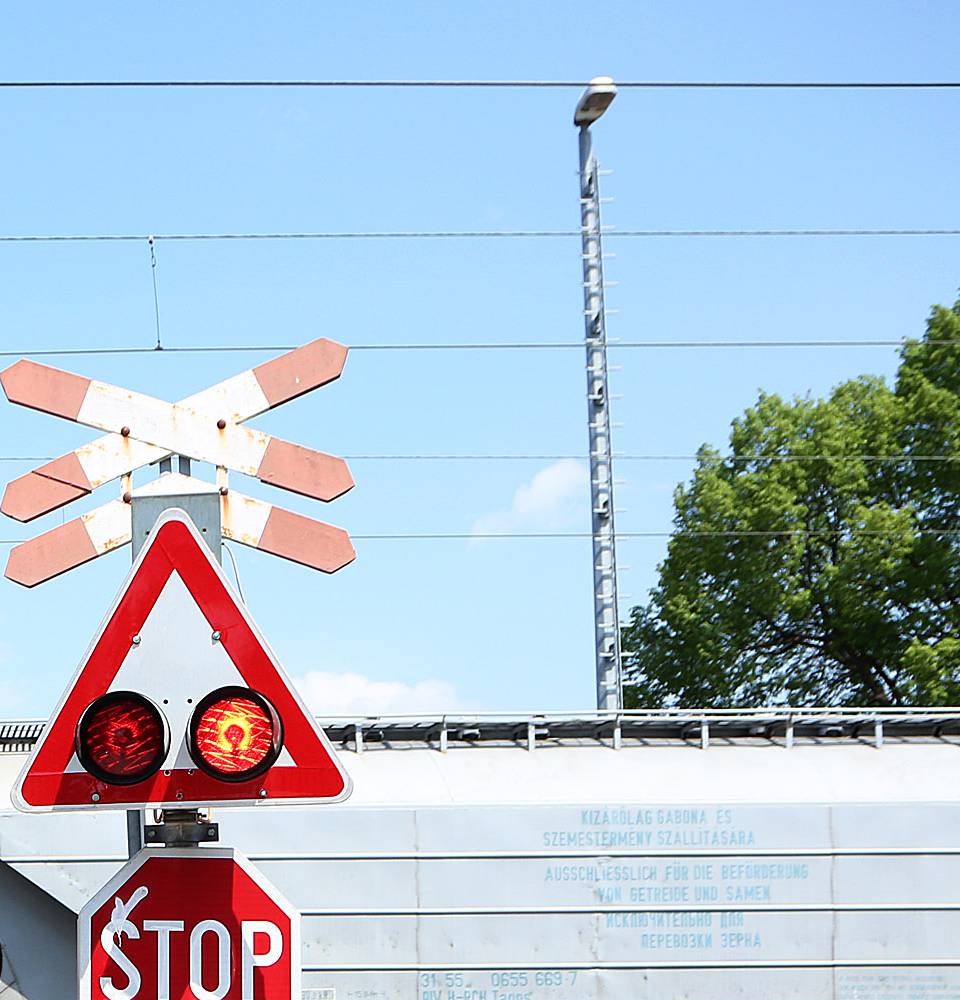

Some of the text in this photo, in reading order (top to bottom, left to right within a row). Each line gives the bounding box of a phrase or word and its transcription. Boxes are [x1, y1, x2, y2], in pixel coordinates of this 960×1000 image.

[657, 809, 706, 825] GABONA
[716, 806, 732, 824] ÉS
[544, 866, 657, 881] AUSSCHLIESSLICH
[664, 861, 689, 881] FÜR
[694, 864, 713, 880] DIE
[630, 886, 689, 901] GETREIDE
[695, 885, 717, 900] UND
[726, 885, 771, 901] SAMEN
[641, 932, 762, 949] ПЕРЕВОЗКИ ЗЕРНА
[420, 973, 437, 988] 31
[445, 973, 464, 988] 55
[491, 972, 528, 987] 0655
